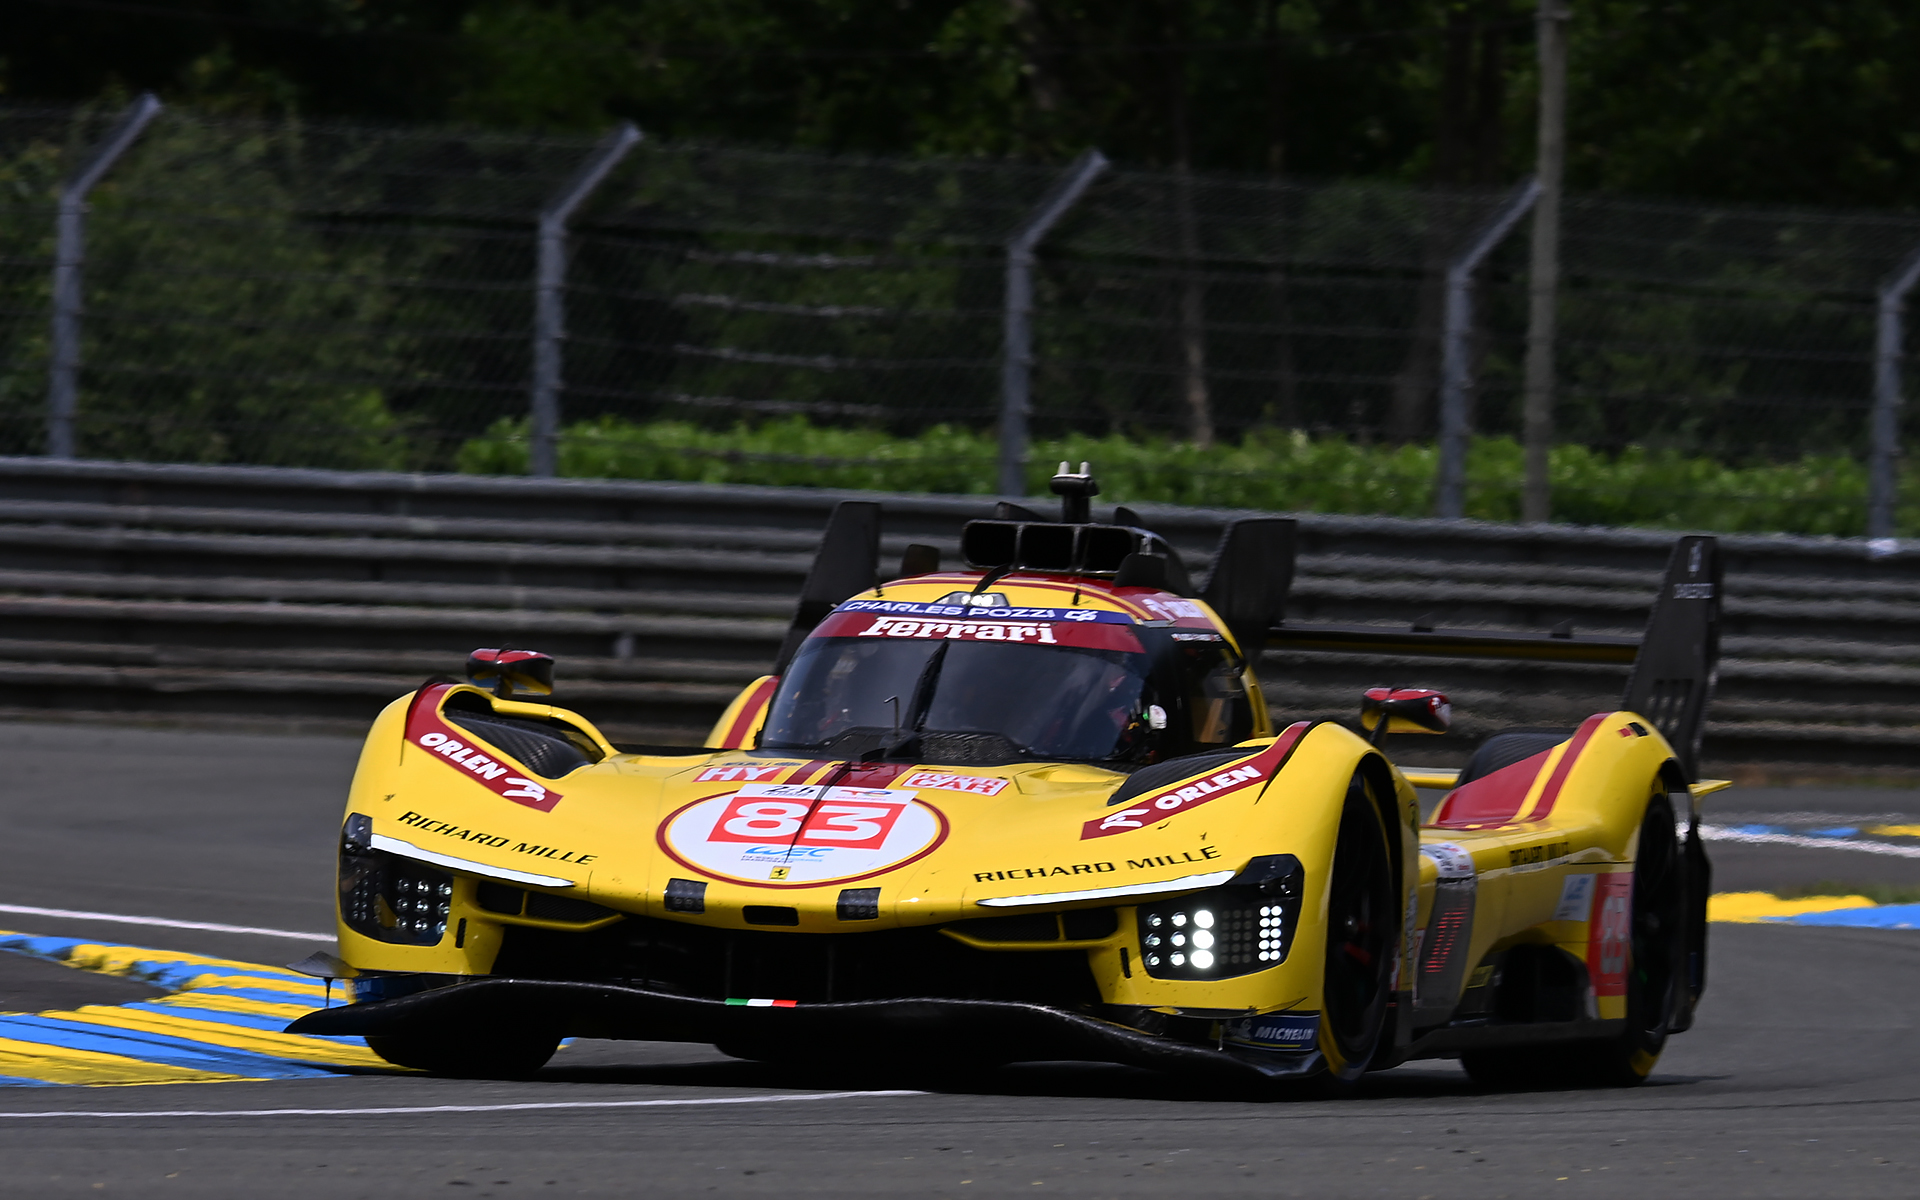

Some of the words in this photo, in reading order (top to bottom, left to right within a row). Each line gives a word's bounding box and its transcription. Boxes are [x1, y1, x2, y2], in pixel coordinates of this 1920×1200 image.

[844, 601, 963, 616] CHARLES
[968, 607, 1056, 618] POZZI
[858, 616, 1057, 644] Ferrari
[419, 732, 508, 781] ORLEN
[697, 767, 780, 781] HY
[911, 779, 995, 793] CAR
[1155, 765, 1262, 810] ORLEN
[723, 801, 892, 841] 83
[397, 811, 510, 848] RICHARD
[511, 842, 598, 865] MILLE
[745, 846, 834, 857] WEC
[973, 862, 1116, 883] RICHARD
[1126, 845, 1222, 870] MILLE
[1255, 1025, 1315, 1041] MICHELIN
